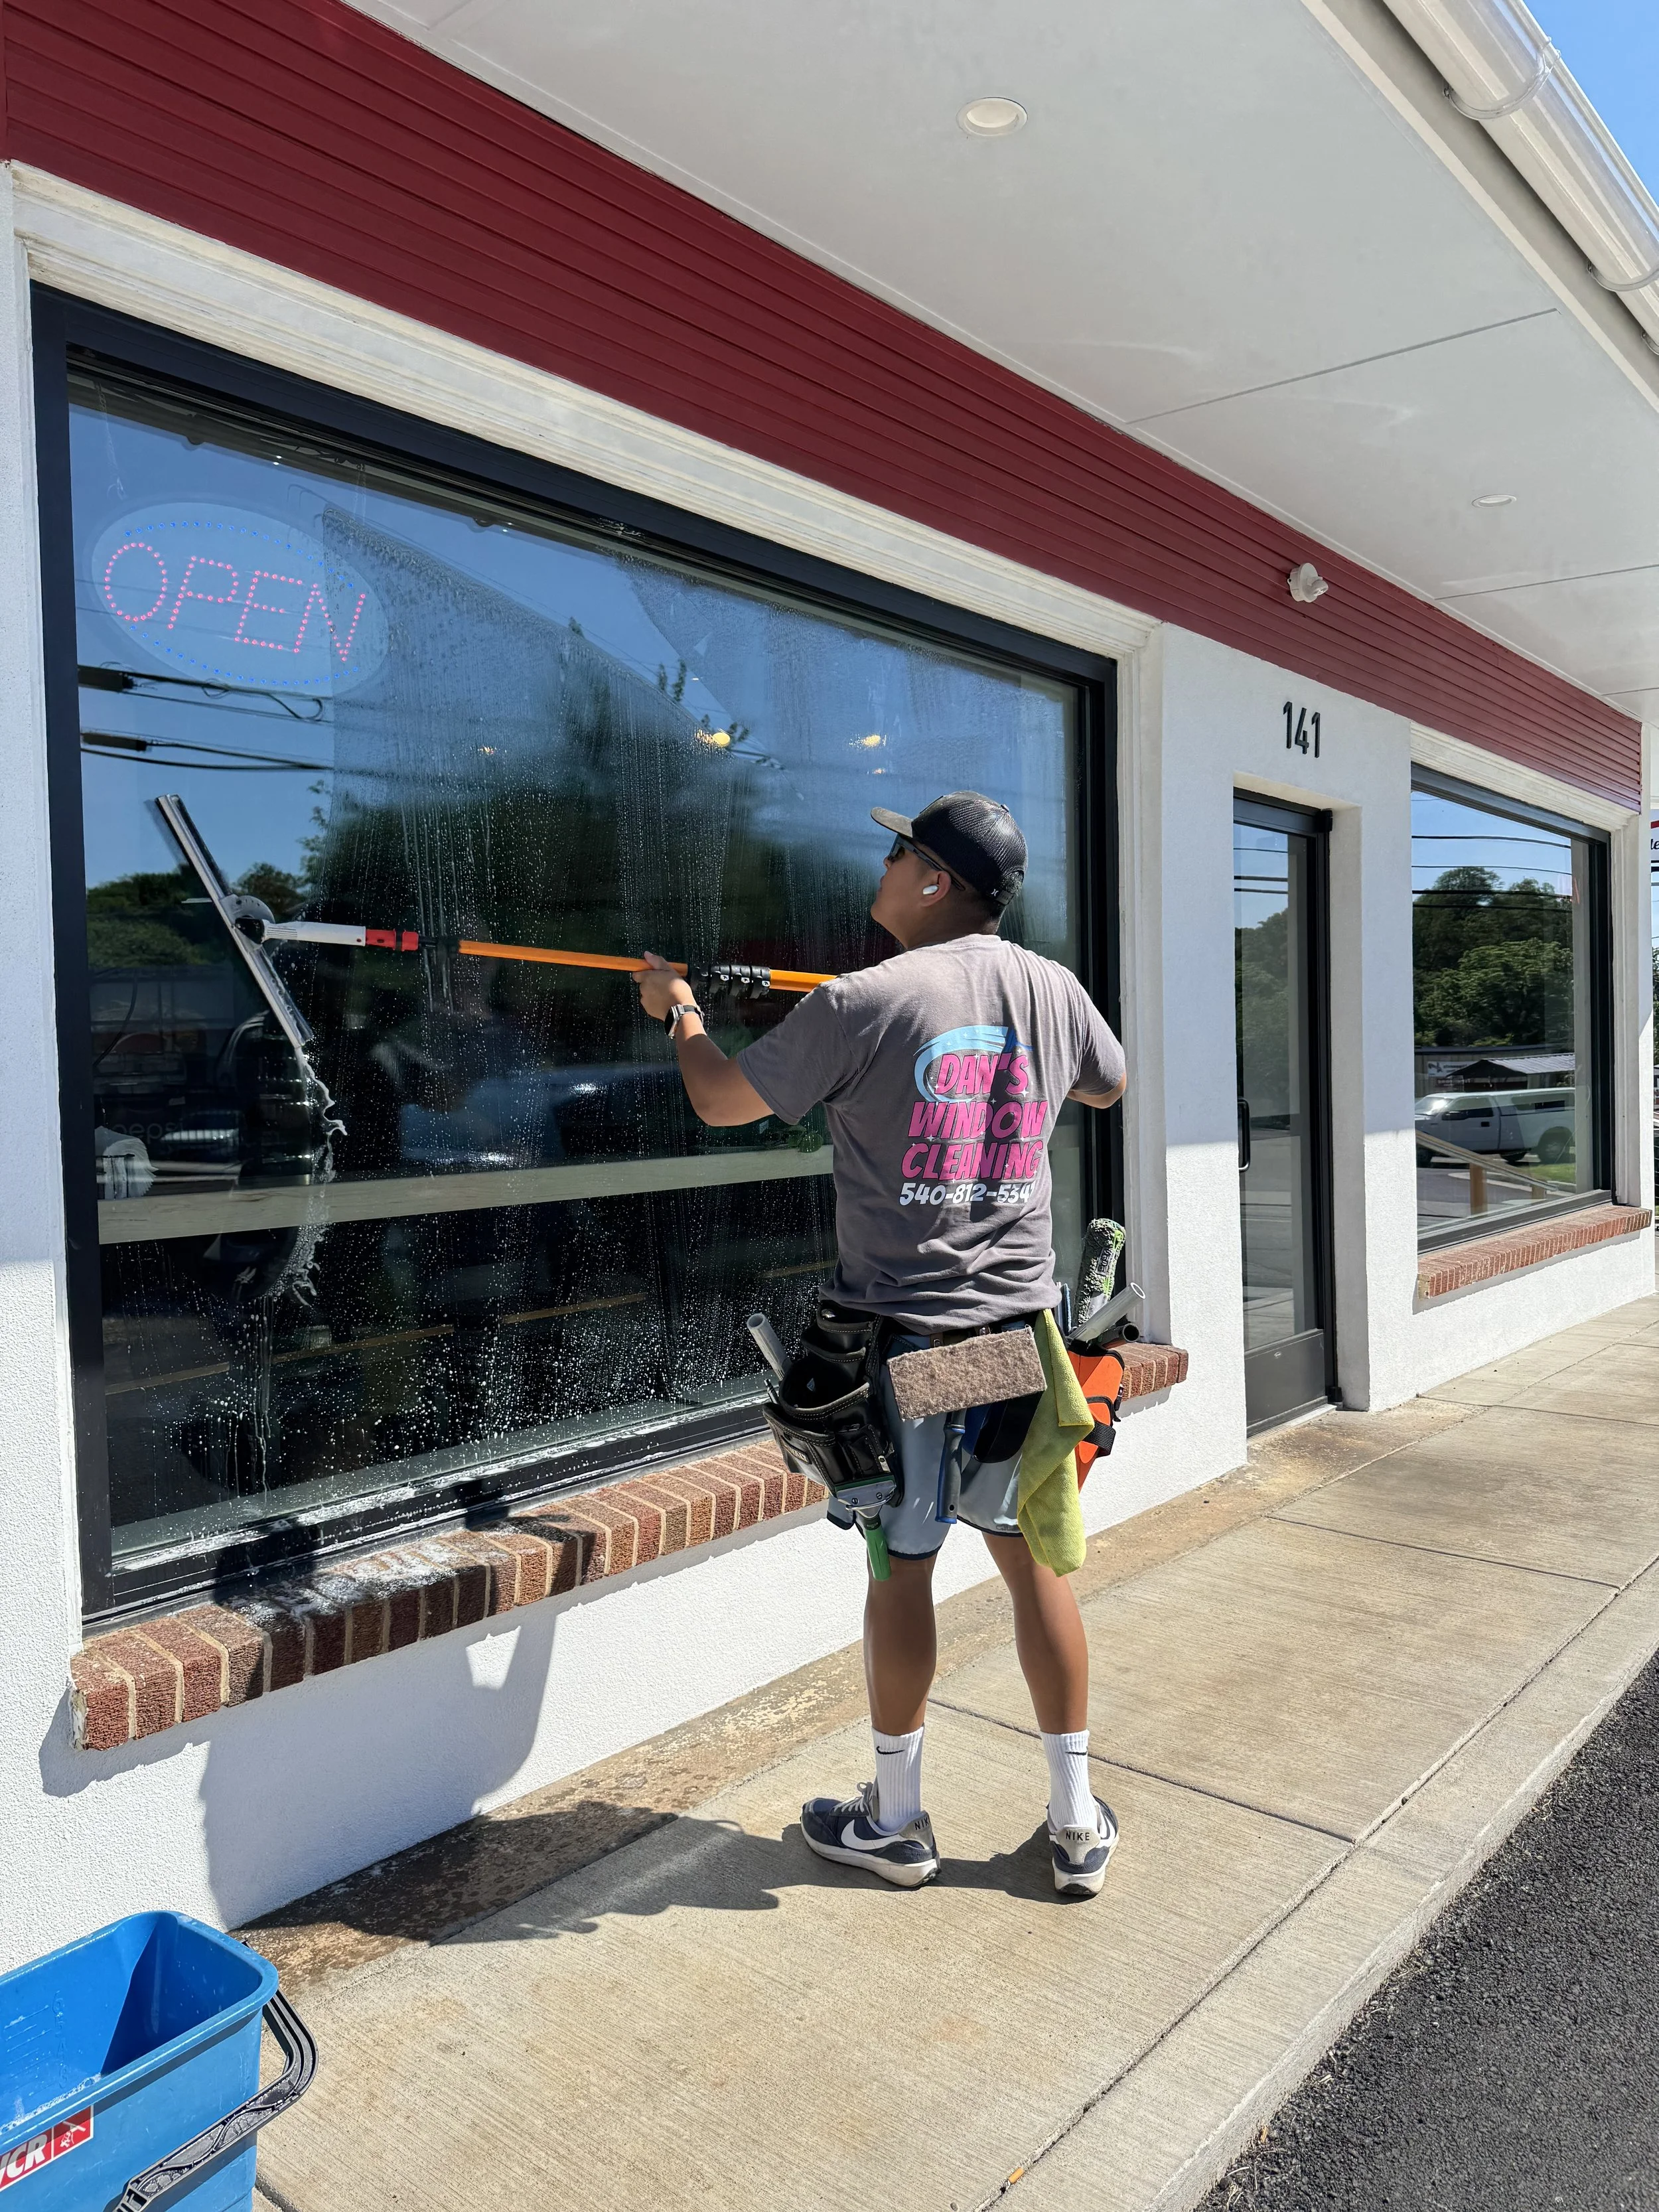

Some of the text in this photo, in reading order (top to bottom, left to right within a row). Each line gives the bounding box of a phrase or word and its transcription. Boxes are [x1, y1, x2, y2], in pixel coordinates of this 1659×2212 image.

[104, 542, 366, 662] OPEN
[1283, 701, 1321, 758] 141
[934, 1053, 1029, 1095] DAN'S
[908, 1100, 1048, 1140] WINDOW
[901, 1140, 1043, 1181] CLEANING
[1065, 1830, 1090, 1841] NIKE
[0, 2134, 48, 2186] CR
